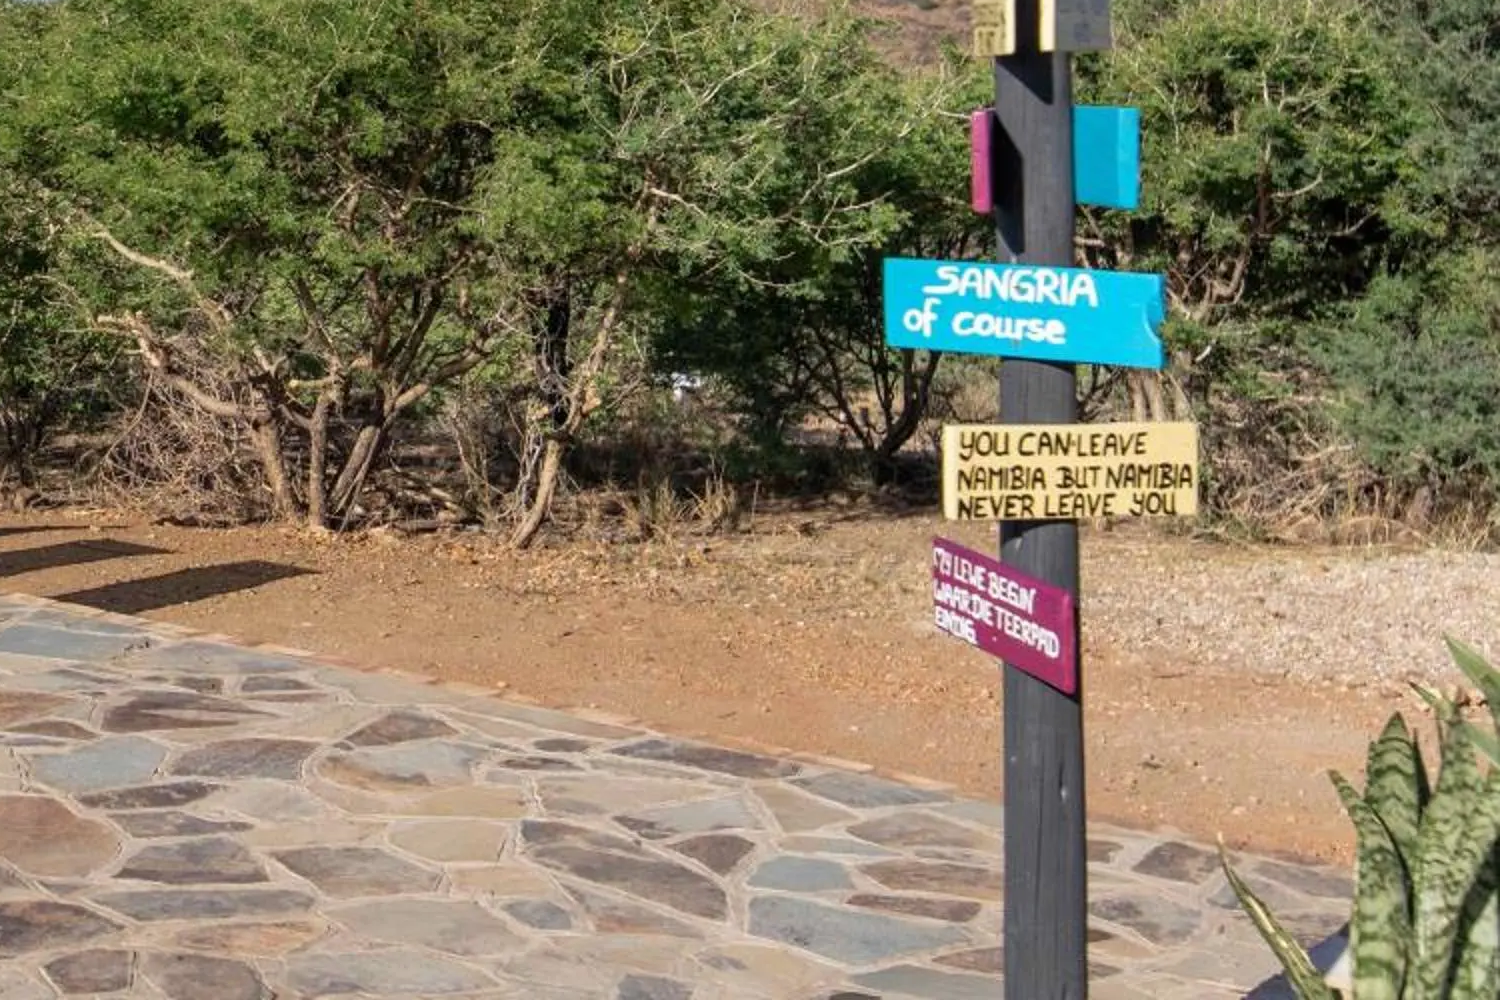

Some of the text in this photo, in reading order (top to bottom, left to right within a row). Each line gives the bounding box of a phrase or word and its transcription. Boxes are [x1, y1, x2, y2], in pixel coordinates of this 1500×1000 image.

[923, 266, 1098, 307] SANGRIA
[903, 298, 1066, 344] of course
[959, 431, 1148, 461] YOU CAN LEAVE
[957, 464, 1193, 491] NAMIBIA BUT NAMIBIA
[957, 492, 1176, 519] NEVER LEAVE YOU
[987, 572, 1036, 615] BEGIN
[994, 606, 1061, 659] TEERPAD
